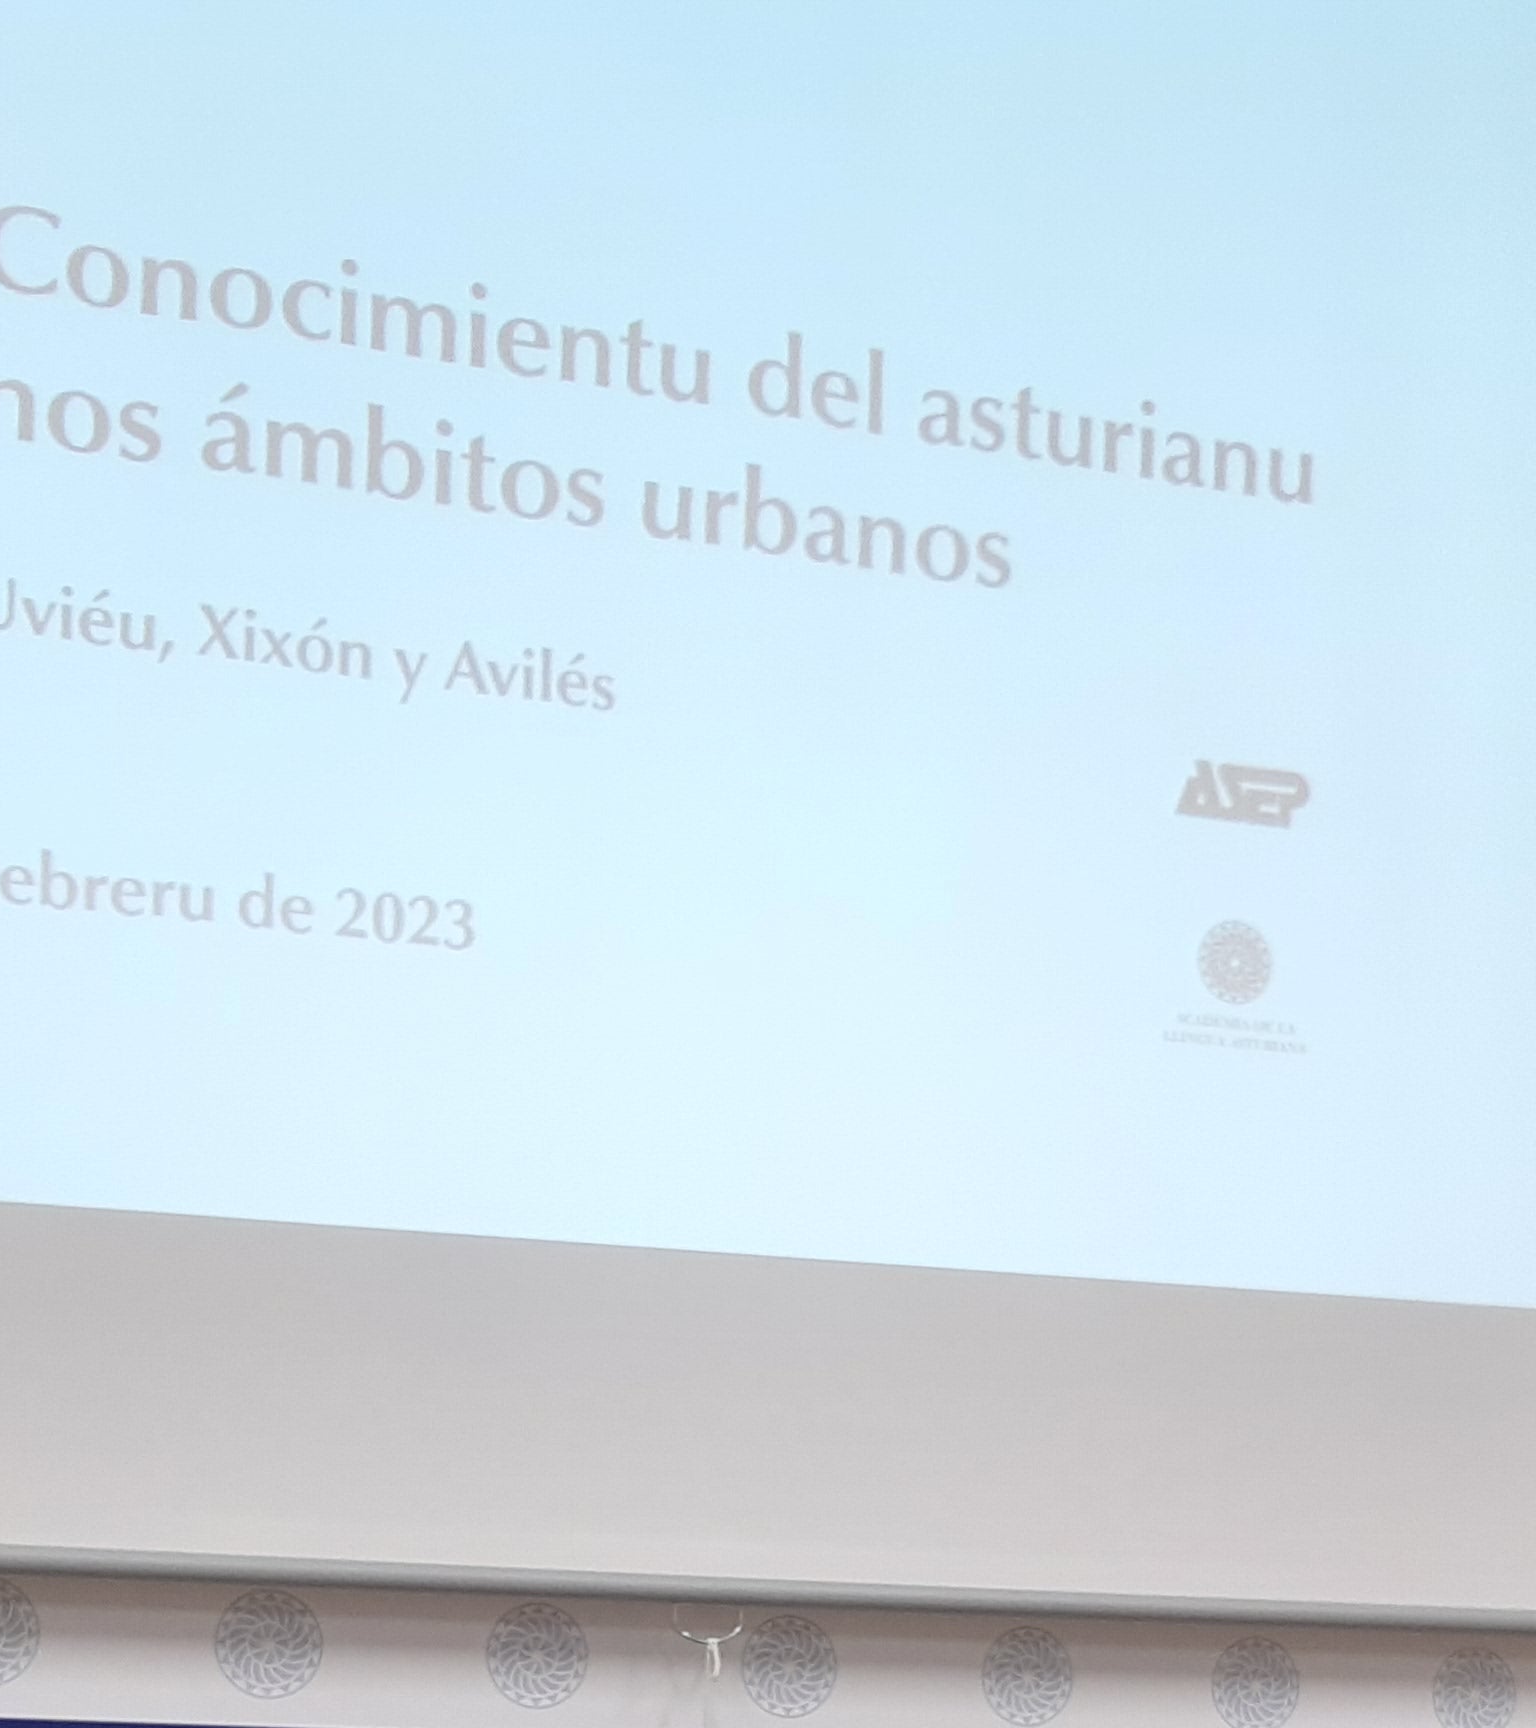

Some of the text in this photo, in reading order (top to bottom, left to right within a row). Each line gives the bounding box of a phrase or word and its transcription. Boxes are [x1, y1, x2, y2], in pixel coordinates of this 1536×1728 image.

[200, 383, 606, 529] ámbitos
[640, 464, 1014, 590] urbanos
[747, 331, 887, 435] del
[917, 377, 1317, 506] asturianu
[197, 604, 373, 680] Xixón
[392, 645, 429, 702] y
[444, 641, 617, 712] Avilés
[235, 873, 315, 937] de
[334, 888, 478, 954] 2023
